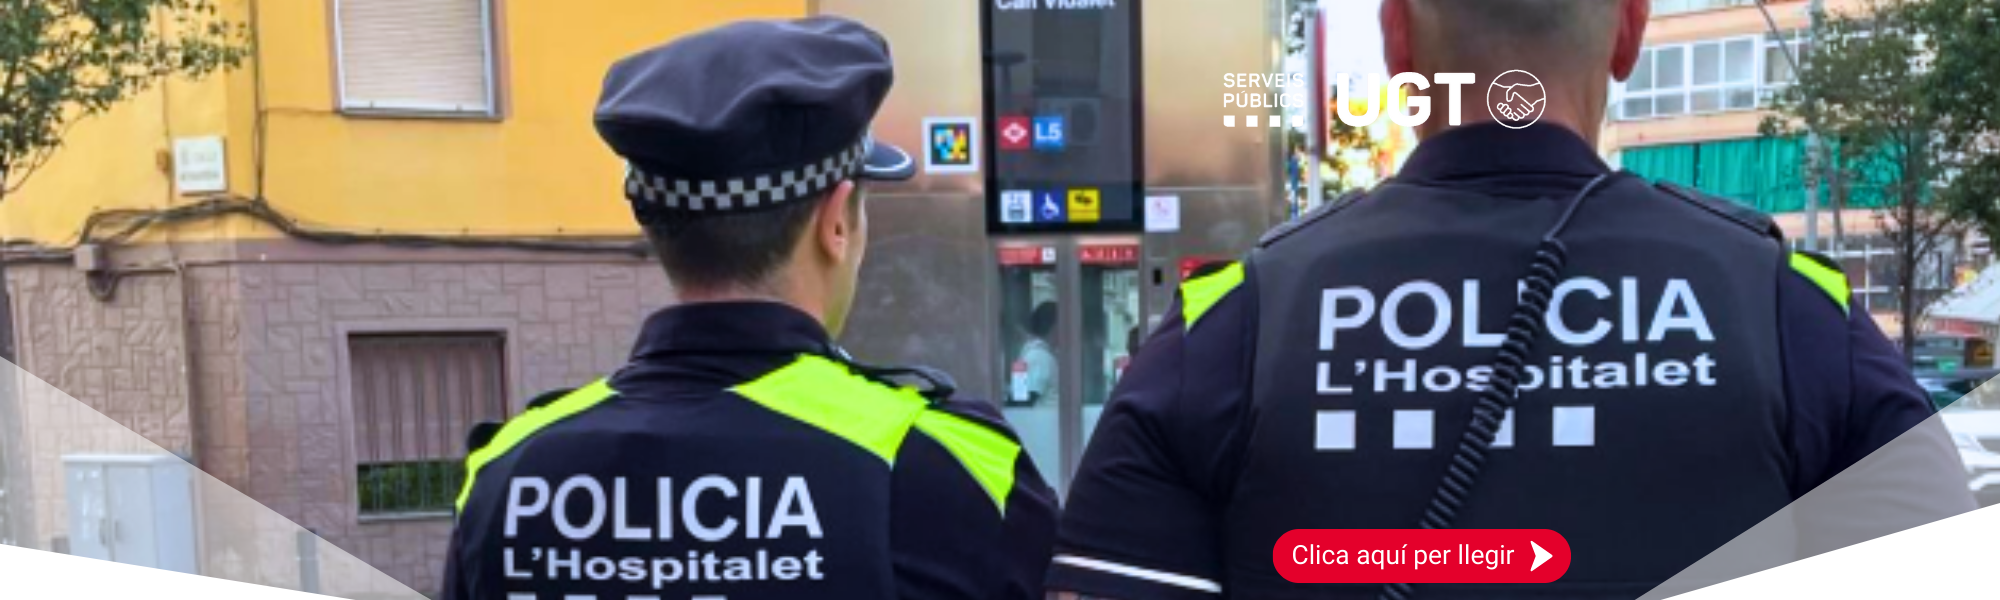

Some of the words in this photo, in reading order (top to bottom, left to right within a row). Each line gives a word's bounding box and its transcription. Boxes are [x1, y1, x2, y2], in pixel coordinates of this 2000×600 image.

[1035, 121, 1062, 139] L5
[1318, 277, 1716, 351] POLCIA
[503, 474, 823, 541] POLICIA
[503, 547, 824, 588] L’Hospitalet
